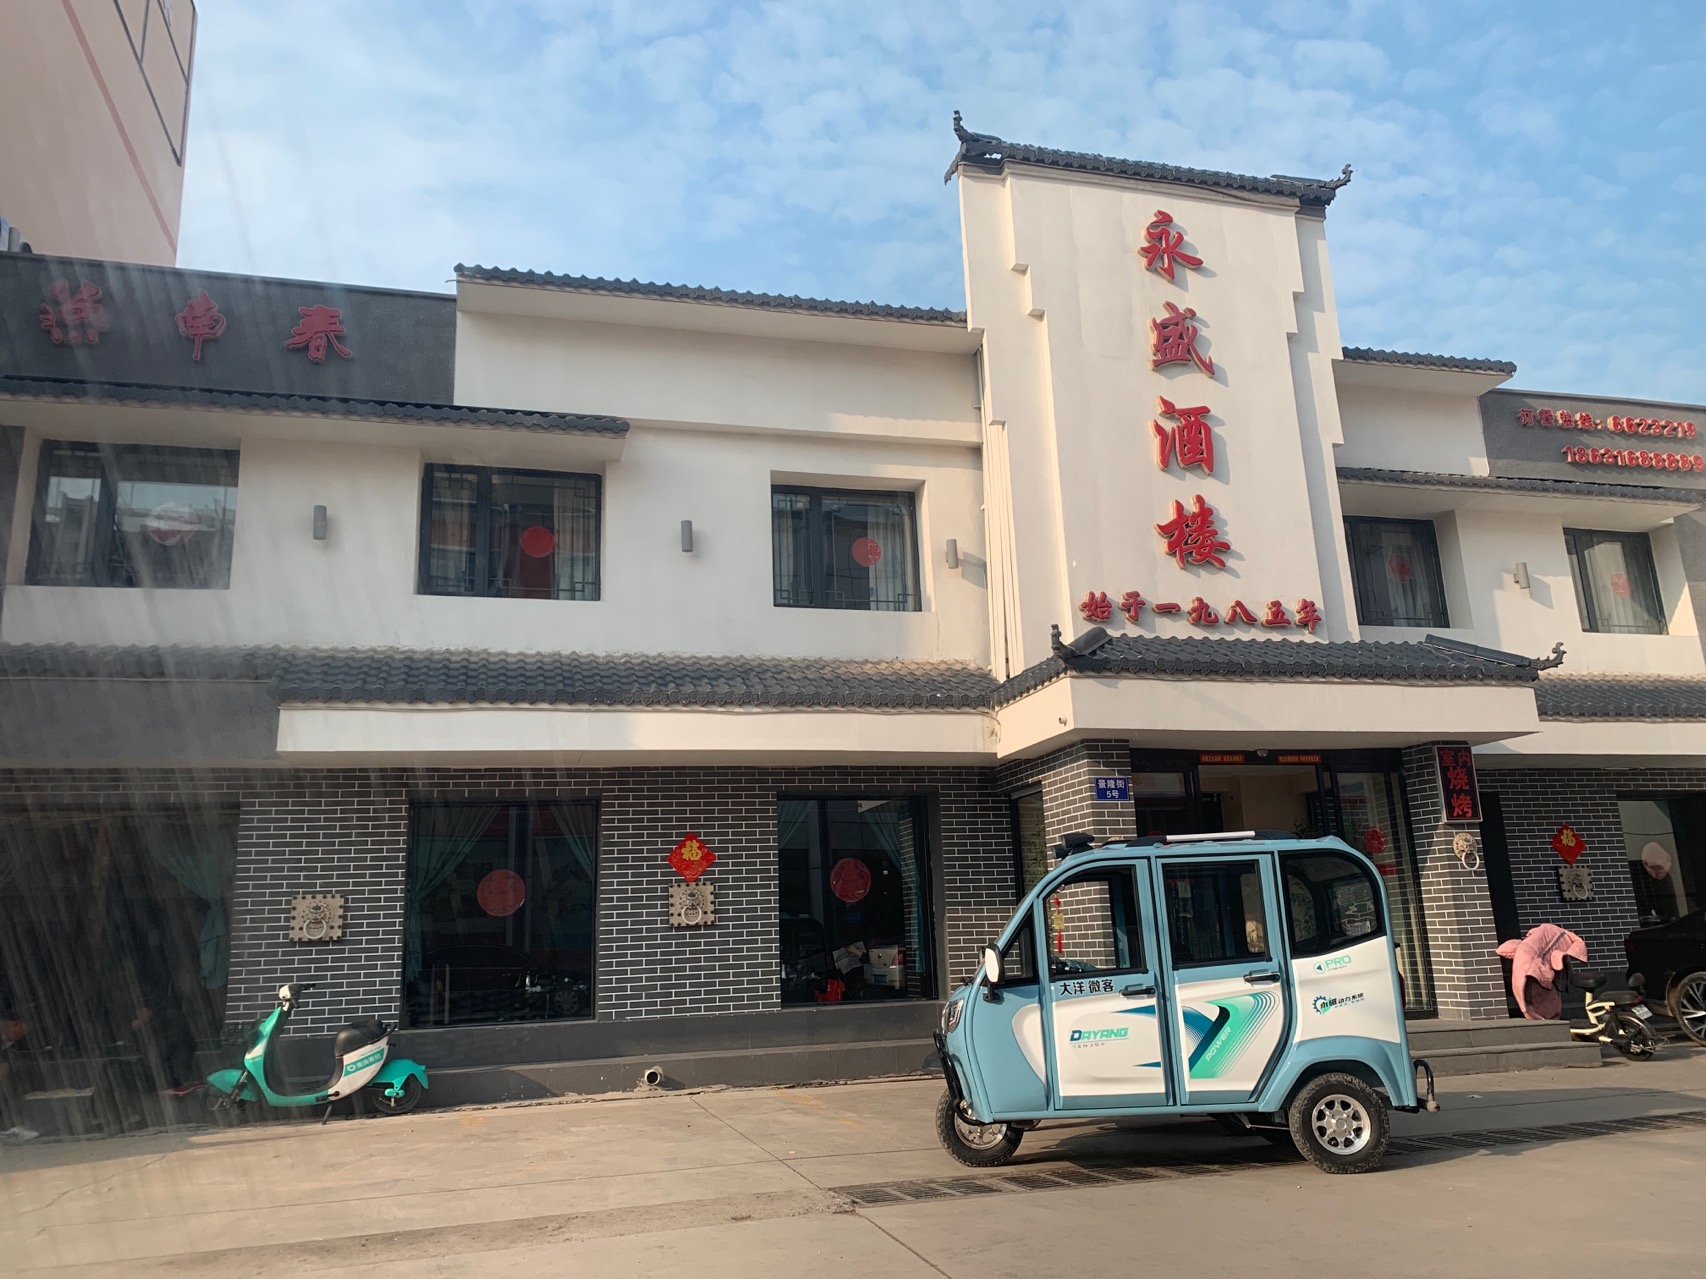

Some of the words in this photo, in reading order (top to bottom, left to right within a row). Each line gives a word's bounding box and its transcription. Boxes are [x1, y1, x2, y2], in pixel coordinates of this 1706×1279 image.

[1138, 209, 1231, 569] 永盛酒楼
[1562, 445, 1704, 472] 18631688889
[1079, 590, 1322, 633] 始于一九八五年
[1106, 789, 1120, 799] 5号
[1560, 829, 1576, 846] 福
[681, 839, 702, 861] 福
[1325, 955, 1352, 968] PRO
[1070, 1027, 1129, 1042] DAYANG
[1205, 1026, 1231, 1062] POWER
